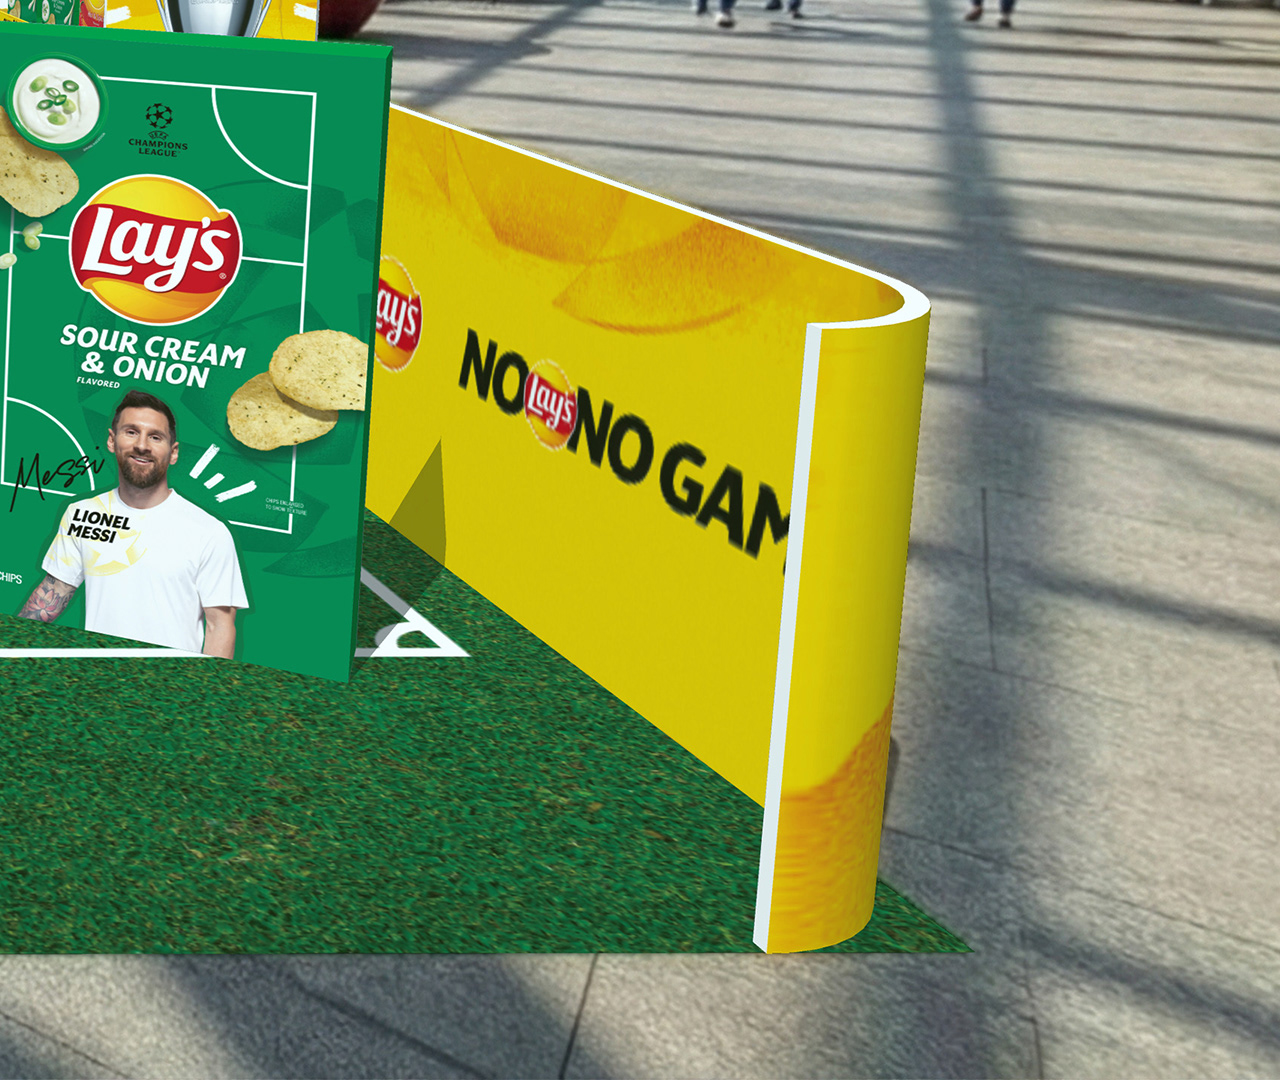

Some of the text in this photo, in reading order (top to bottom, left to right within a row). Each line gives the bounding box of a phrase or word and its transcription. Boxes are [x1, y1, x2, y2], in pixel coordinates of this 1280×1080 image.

[128, 138, 188, 150] CHAMPIONS
[138, 147, 177, 158] LEAGUE
[80, 207, 232, 293] Lay's
[376, 286, 419, 345] ay's
[60, 324, 247, 369] SOUR CREAM
[76, 376, 121, 389] FLAVORED
[80, 351, 211, 389] & ONION
[458, 328, 790, 575] NO Lay's NO GAM
[9, 445, 106, 513] Messi
[66, 524, 117, 544] MESSI
[72, 508, 131, 531] LIONEL
